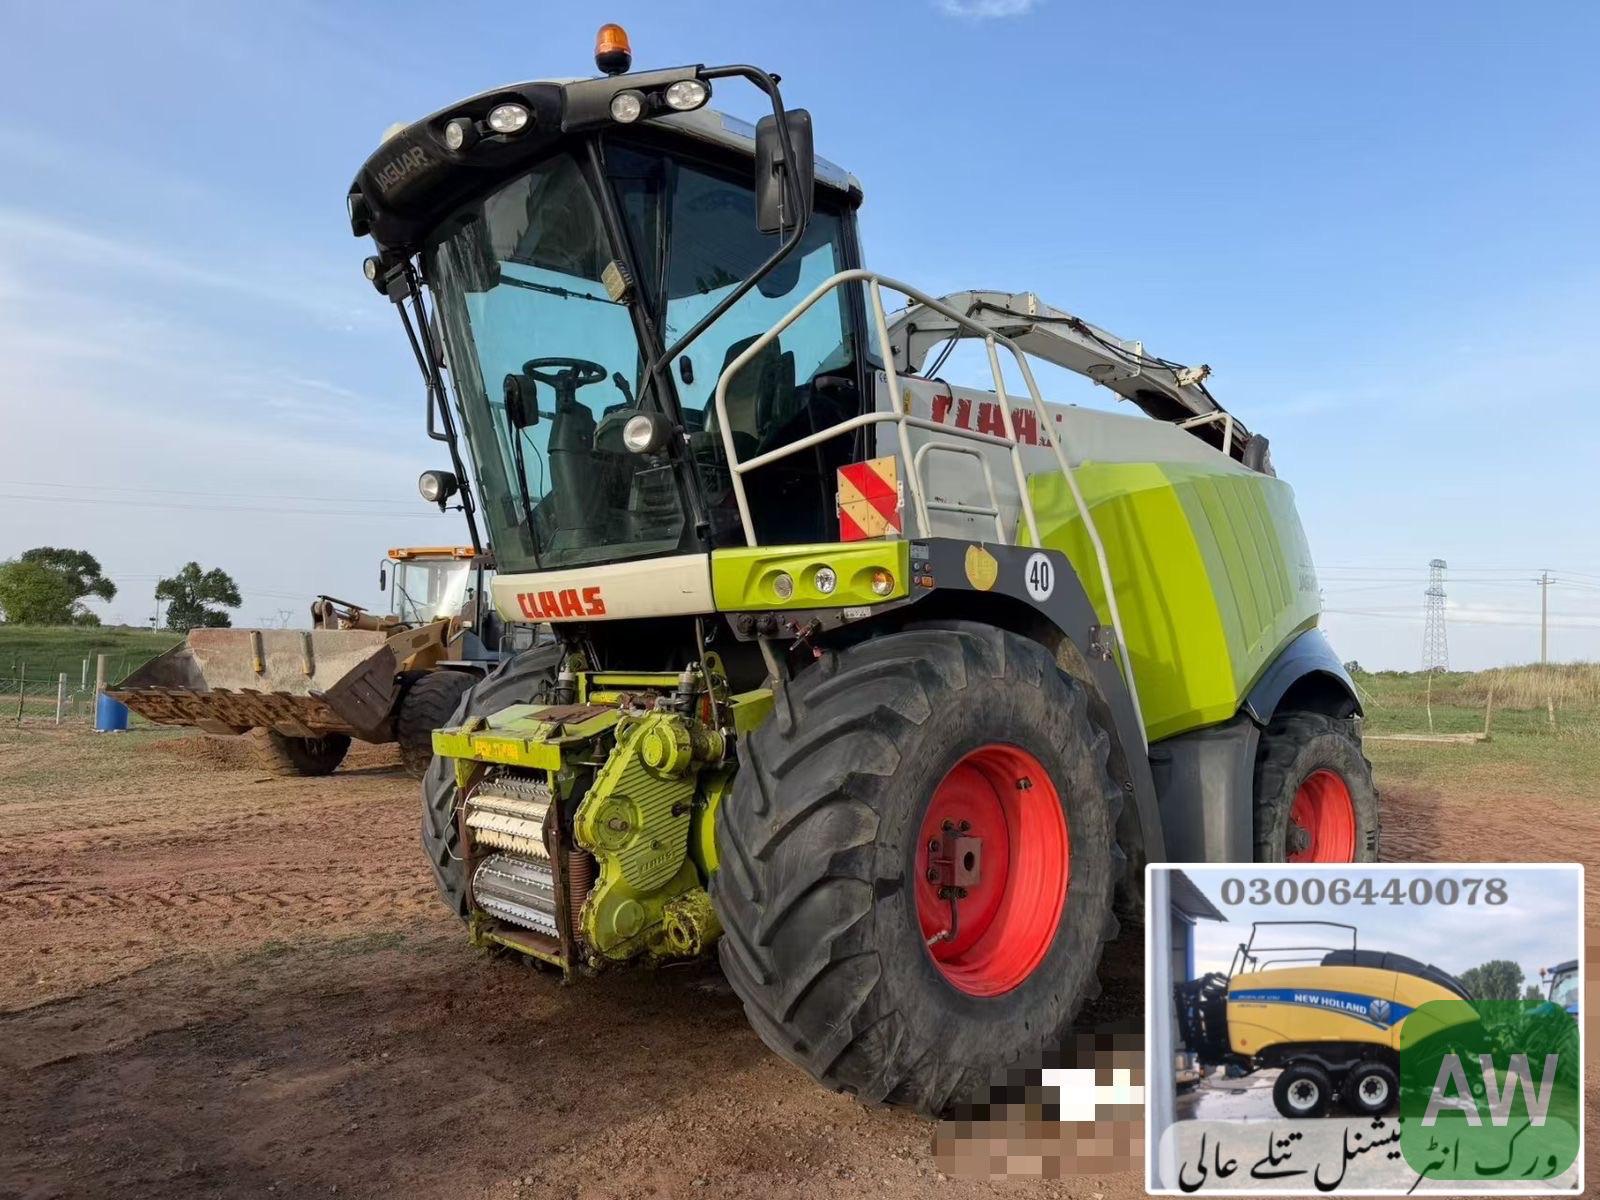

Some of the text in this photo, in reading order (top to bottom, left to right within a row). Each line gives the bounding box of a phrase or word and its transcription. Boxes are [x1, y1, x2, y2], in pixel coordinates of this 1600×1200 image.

[374, 146, 428, 192] JAGUAR
[1030, 560, 1050, 592] 40
[516, 586, 607, 619] CLAAS
[1294, 993, 1320, 1004] NEW
[1321, 997, 1368, 1015] HOLLAND
